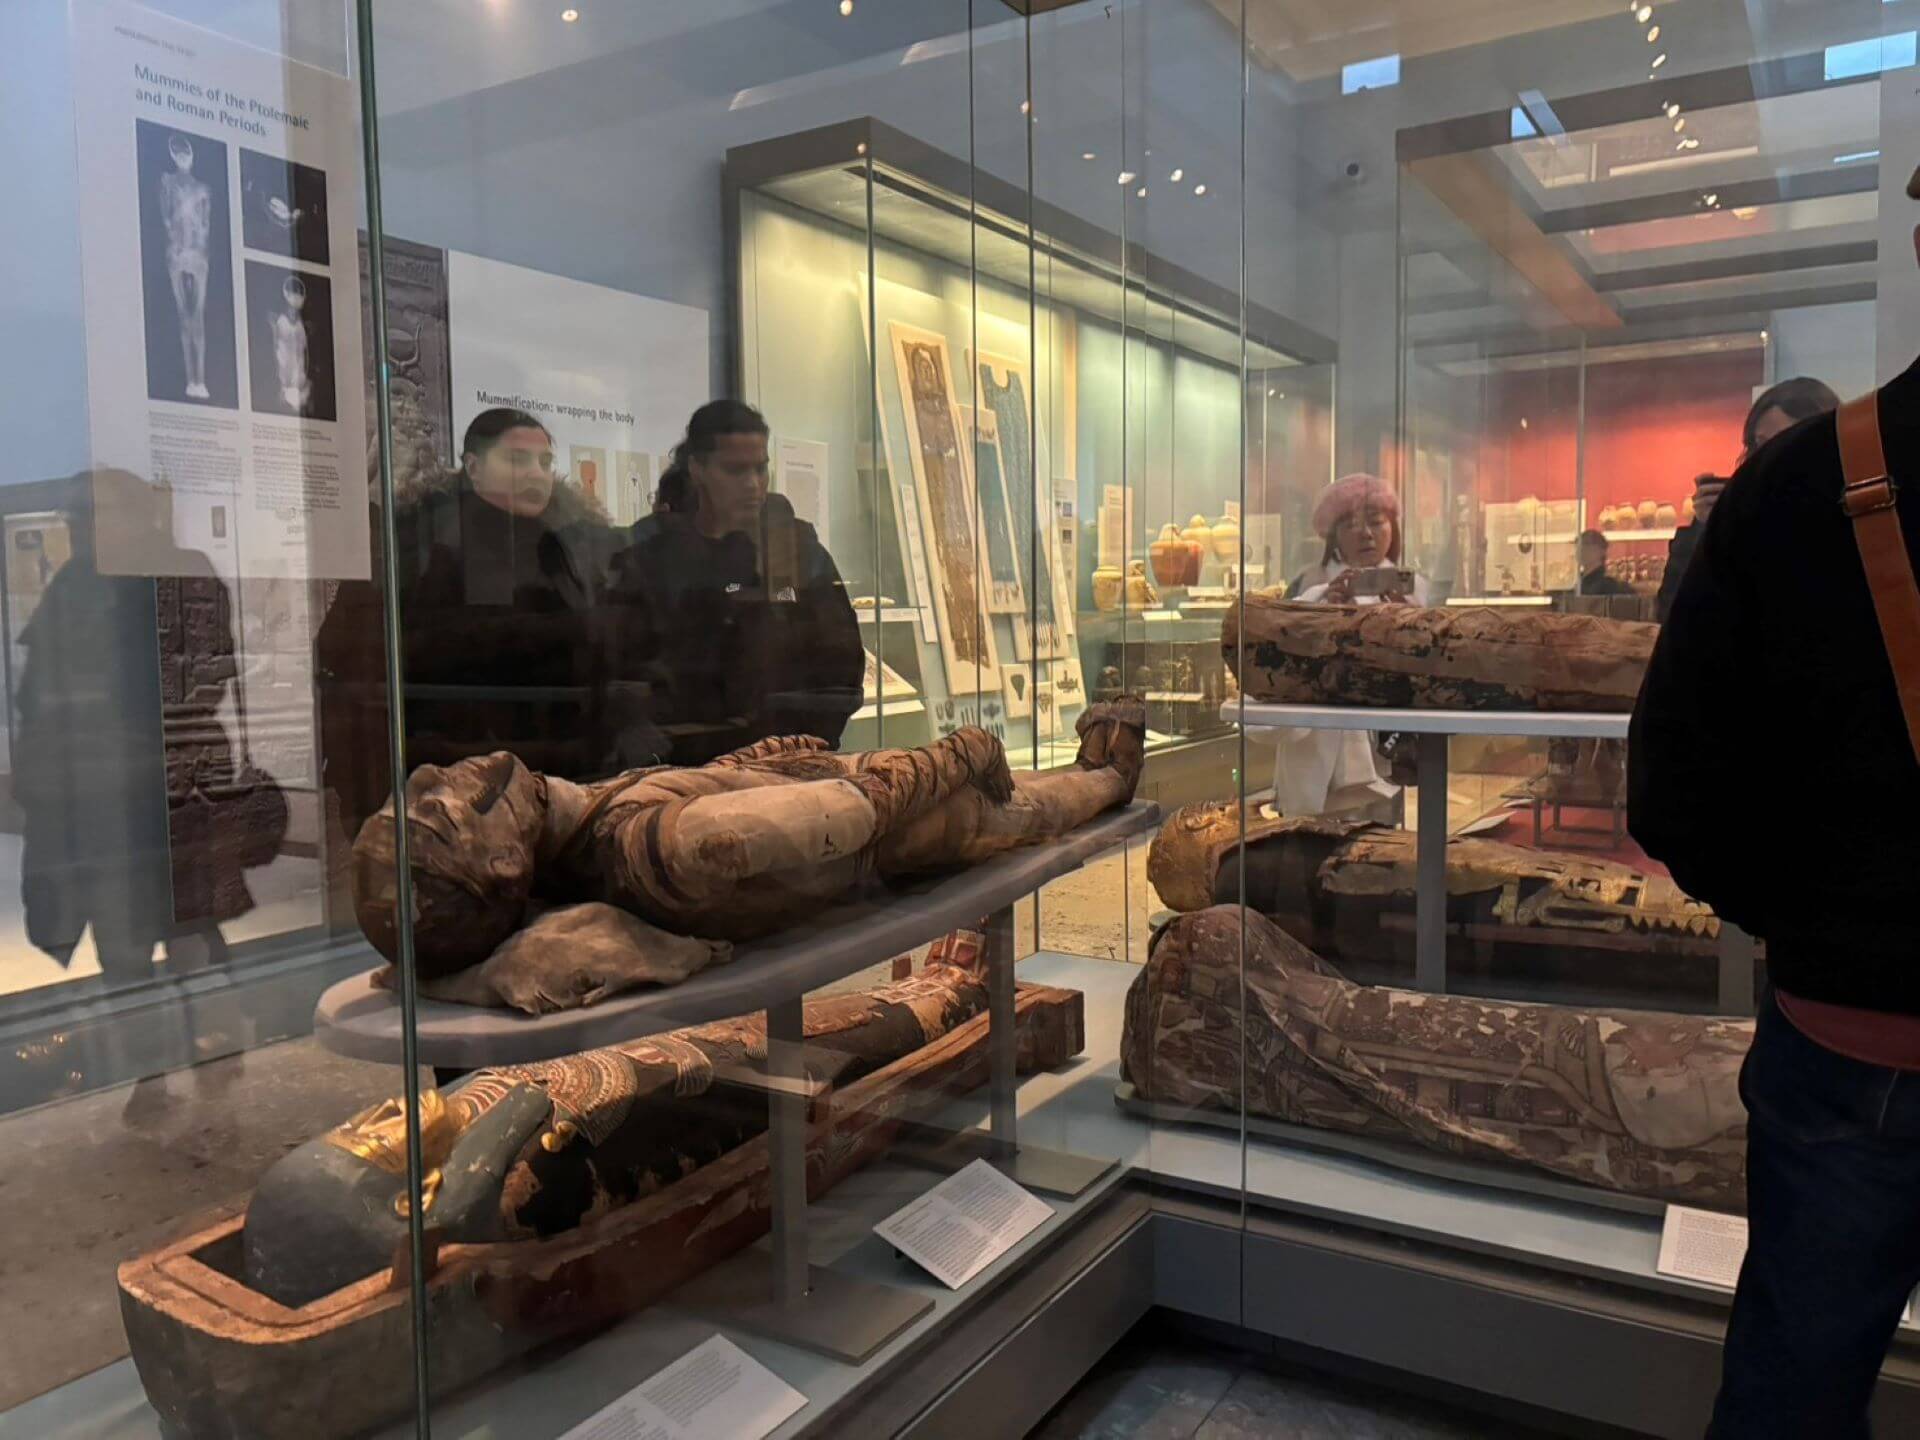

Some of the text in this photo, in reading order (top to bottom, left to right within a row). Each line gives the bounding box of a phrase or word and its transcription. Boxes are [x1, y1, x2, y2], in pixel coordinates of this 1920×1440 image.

[134, 63, 310, 130] Mummies of the Ptolemaic
[135, 88, 267, 137] and Roman Periods
[476, 390, 635, 426] Mummification: wrapping the body
